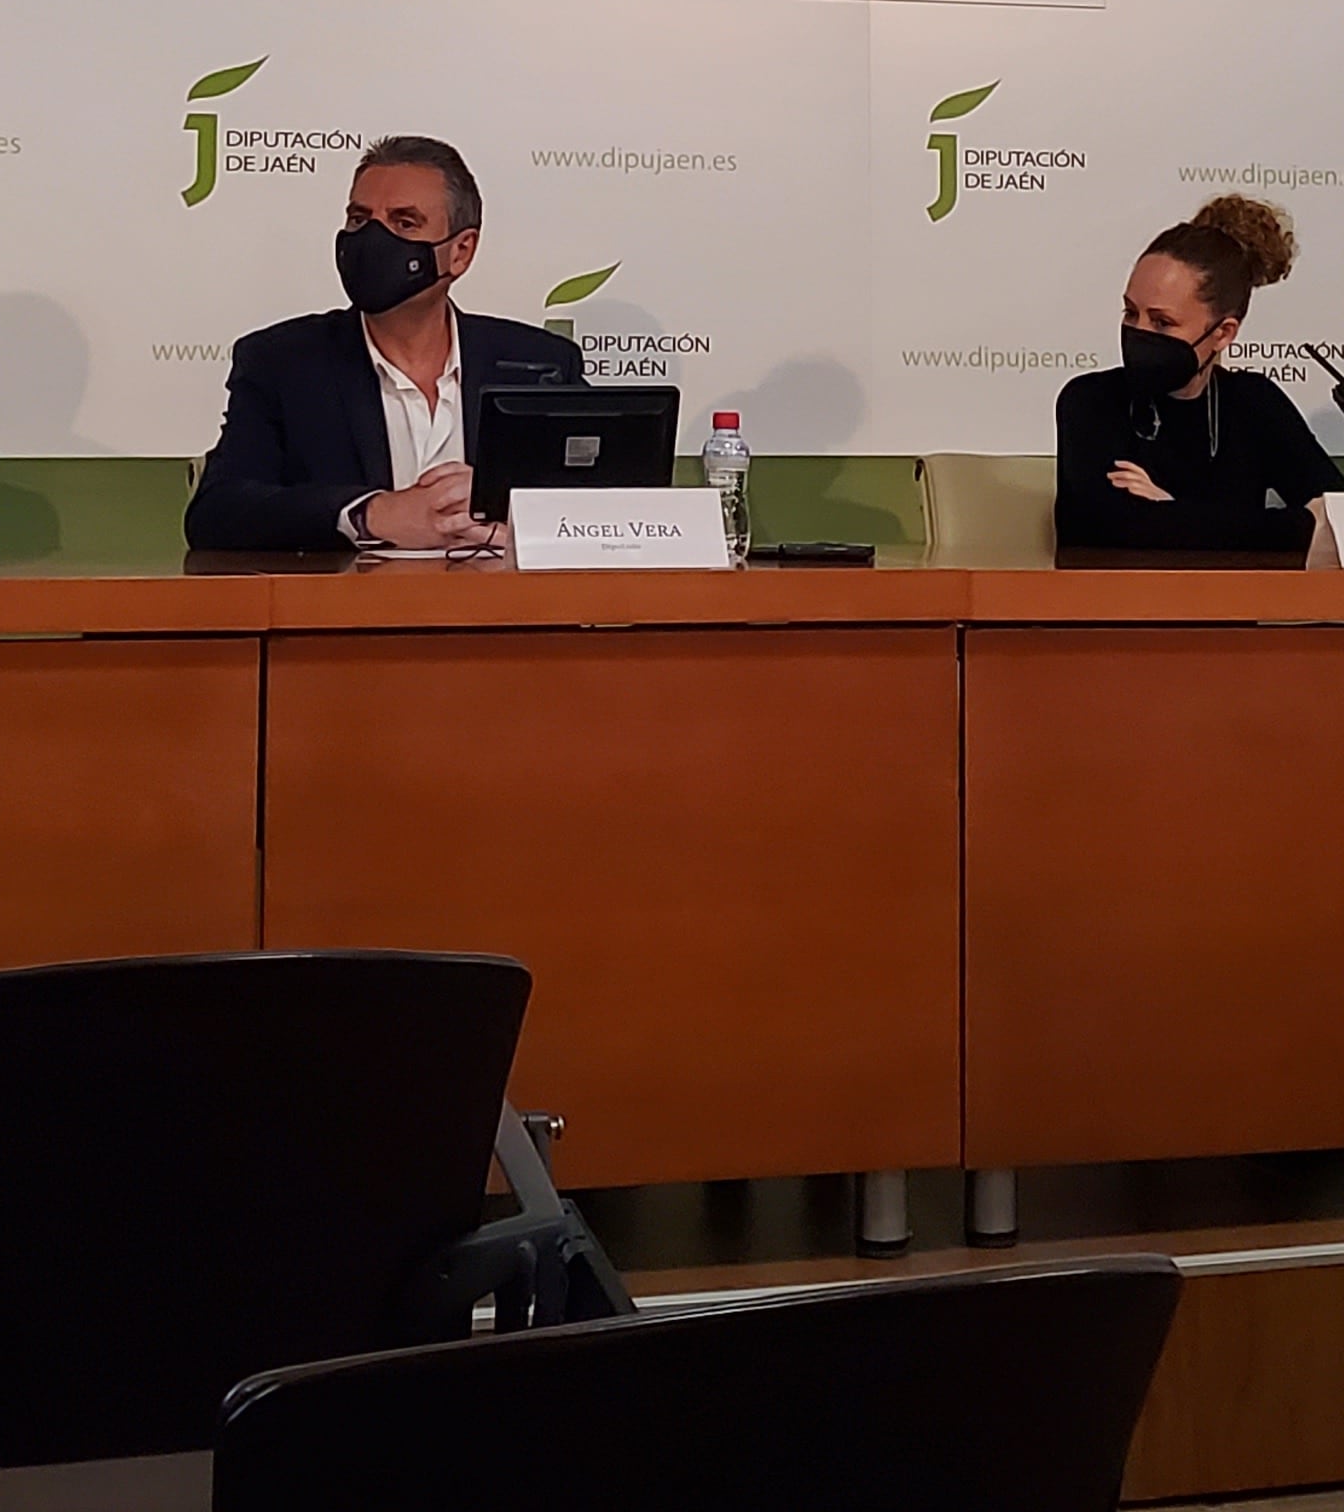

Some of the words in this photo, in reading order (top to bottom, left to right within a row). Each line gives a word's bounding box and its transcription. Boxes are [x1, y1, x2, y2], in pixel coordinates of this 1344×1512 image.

[226, 130, 362, 150] DIPUTACIÓN
[225, 156, 256, 172] DE
[259, 153, 316, 173] JAÉN
[531, 146, 737, 176] www.dipujaen.es
[964, 149, 1085, 169] DIPUTACIÓN
[964, 173, 992, 189] DE
[995, 171, 1045, 190] JAÉN
[582, 333, 710, 353] DIPUTACIÓN
[582, 360, 611, 376] DE
[613, 357, 666, 377] JAÉN
[902, 345, 1099, 374] www.dipujaen.es
